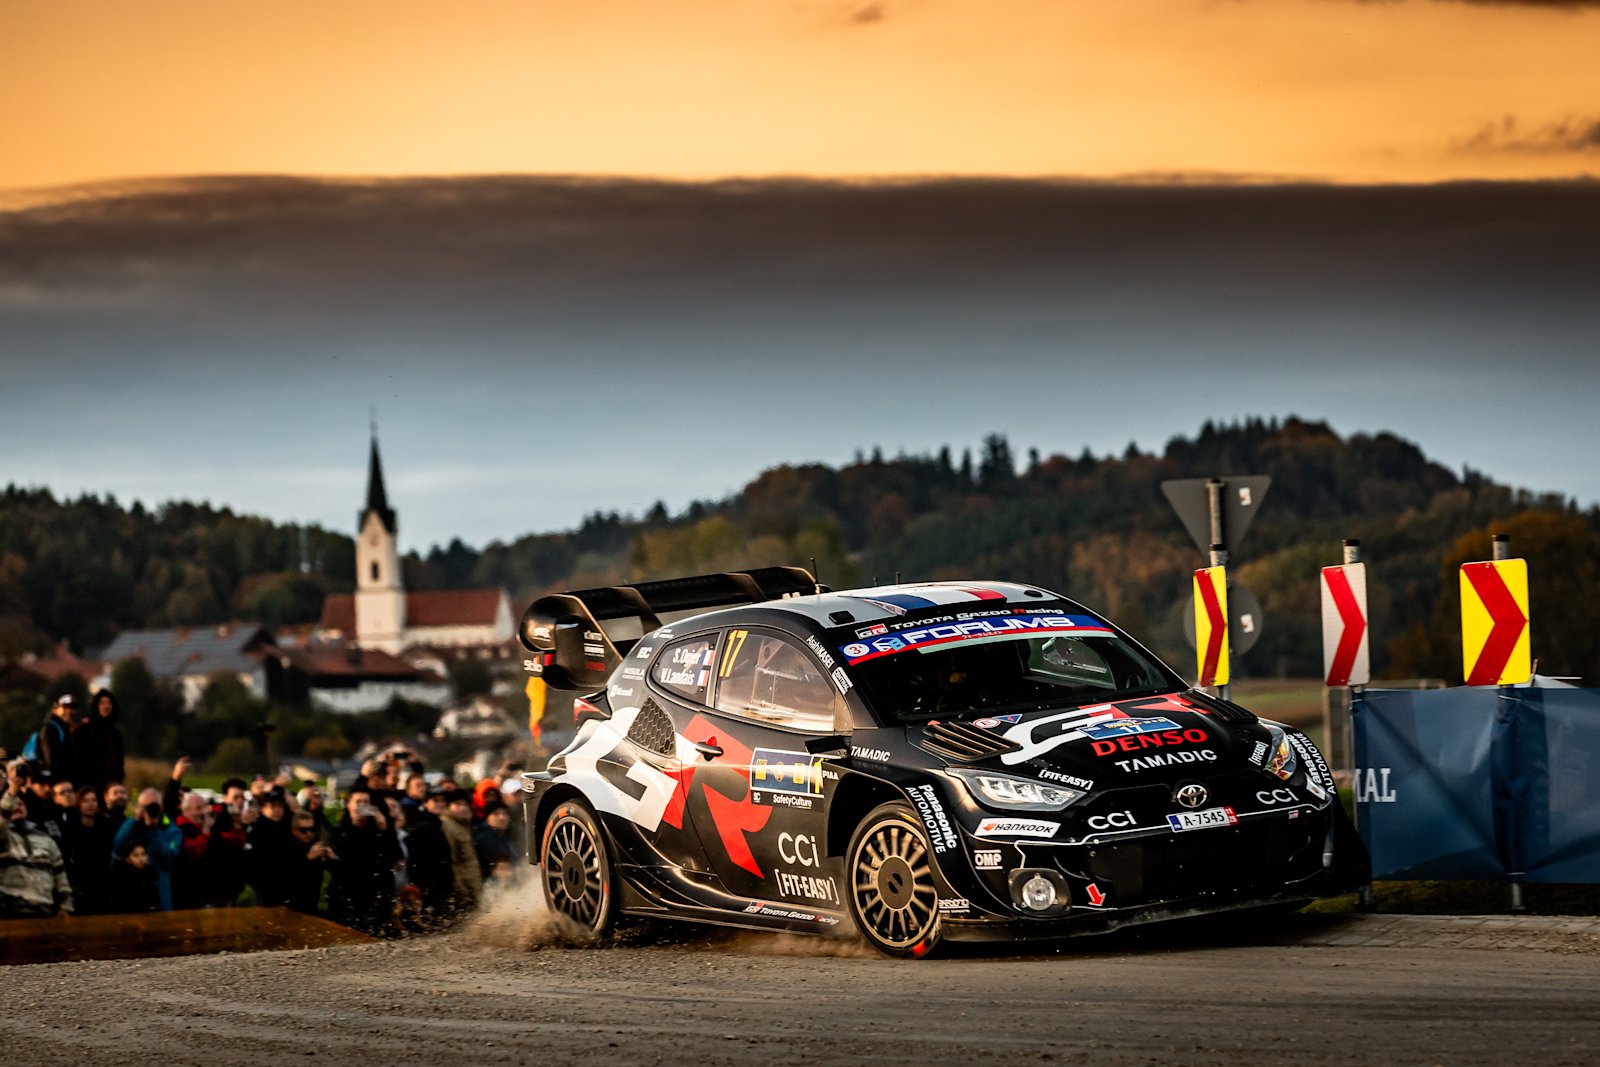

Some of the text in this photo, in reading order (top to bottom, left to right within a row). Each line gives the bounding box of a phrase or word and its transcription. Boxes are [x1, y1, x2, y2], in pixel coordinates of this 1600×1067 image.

[856, 624, 888, 639] GR
[890, 615, 954, 630] TOYOTA
[956, 609, 1012, 621] GAZOO
[902, 617, 1075, 643] FORUM8
[672, 648, 702, 667] S.Ogier
[719, 629, 749, 678] 17
[806, 635, 835, 669] AsahiKASEI
[660, 668, 695, 686] V.Landais
[1119, 724, 1144, 733] 17
[850, 745, 891, 762] TAMADIC
[1089, 729, 1208, 757] DENSO
[1114, 750, 1218, 773] TAMADIC
[1286, 734, 1322, 784] anasonic
[1293, 732, 1336, 794] AUTOMOTIVE
[822, 770, 839, 780] PIAA
[772, 794, 813, 807] SafetyCulture
[905, 787, 946, 853] AUTOMOTIVE
[918, 784, 957, 849] Panasonic
[1184, 811, 1225, 826] A-7545
[974, 853, 1003, 866] OMP
[759, 907, 788, 917] TOYOTA
[787, 911, 815, 921] GAZOO
